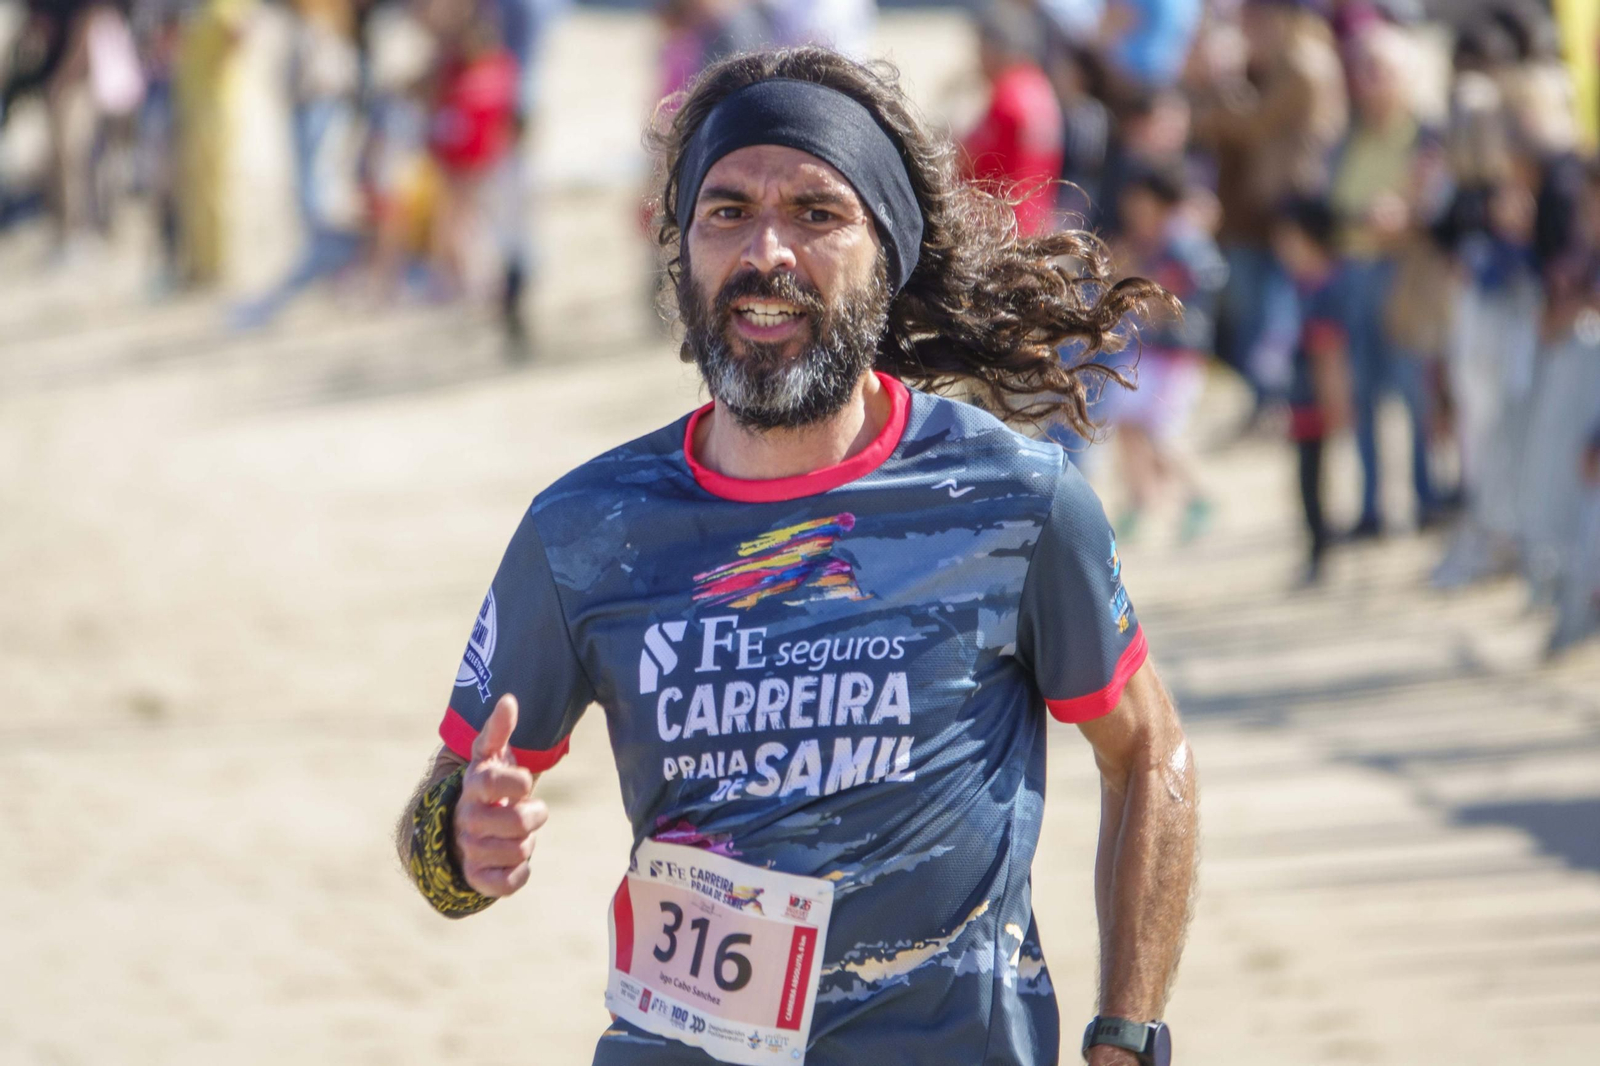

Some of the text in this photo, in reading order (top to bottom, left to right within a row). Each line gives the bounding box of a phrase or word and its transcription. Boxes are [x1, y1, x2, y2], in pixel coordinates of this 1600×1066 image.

[695, 615, 906, 673] FE seguros
[657, 672, 911, 742] CARREIRA
[663, 749, 748, 781] PRAIA
[710, 778, 746, 802] DE
[690, 866, 734, 893] CARREIRA
[691, 880, 713, 897] PRAIA
[714, 889, 722, 901] DE
[653, 901, 752, 992] 316
[671, 1005, 689, 1023] 100
